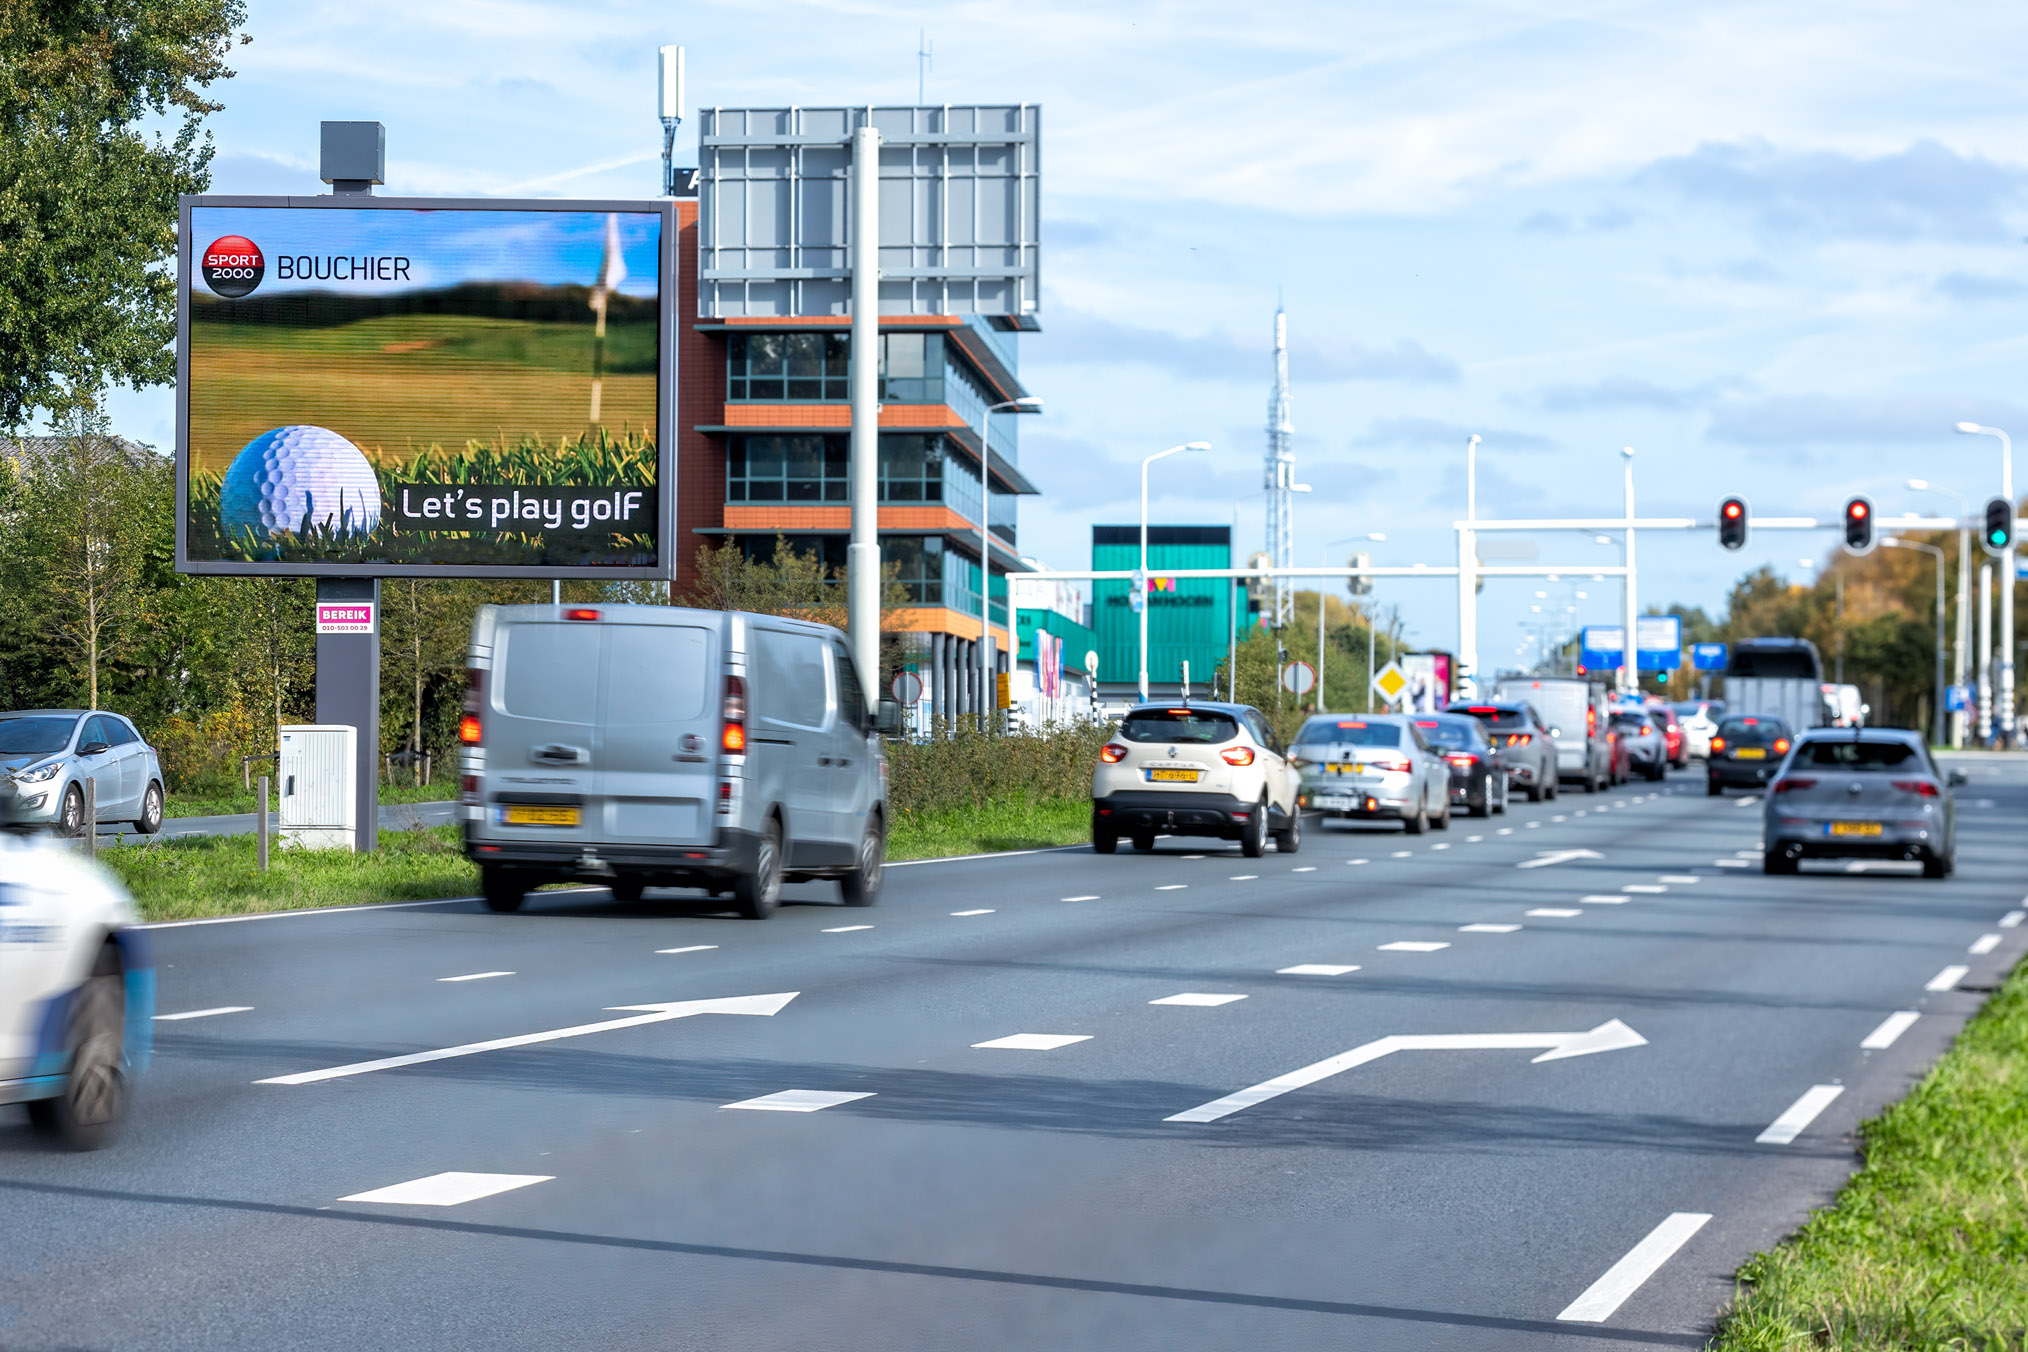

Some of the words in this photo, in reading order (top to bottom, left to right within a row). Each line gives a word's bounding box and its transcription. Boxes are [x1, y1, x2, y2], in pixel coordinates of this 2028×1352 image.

[208, 254, 258, 266] SPORT
[212, 267, 254, 279] 2000
[278, 255, 410, 281] BOUCHIER
[402, 488, 483, 518] Let's
[491, 490, 562, 529] play
[322, 610, 367, 620] BEREIK
